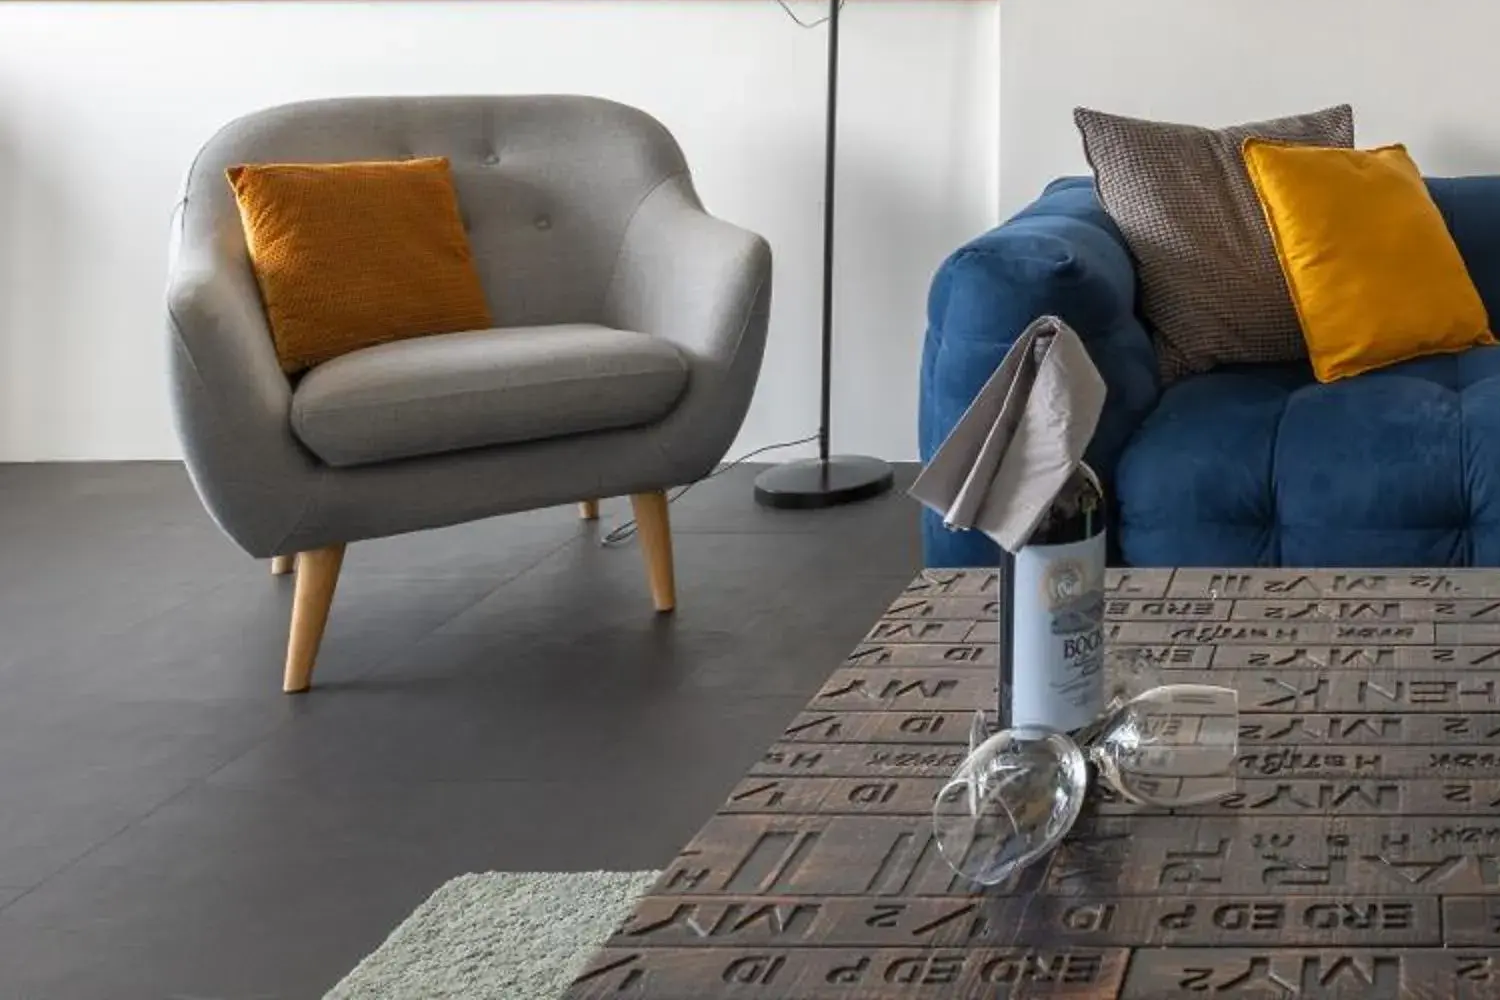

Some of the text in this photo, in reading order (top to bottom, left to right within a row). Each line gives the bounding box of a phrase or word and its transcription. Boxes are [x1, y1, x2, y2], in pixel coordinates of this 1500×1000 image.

[894, 715, 949, 733] ID
[842, 783, 899, 803] ID
[1058, 903, 1120, 931] ID
[1156, 904, 1198, 929] P
[1208, 903, 1286, 929] ED
[1302, 902, 1414, 929] ERD
[713, 955, 789, 984] ID
[820, 956, 874, 984] P
[877, 955, 967, 983] ED
[974, 955, 1103, 983] ERD
